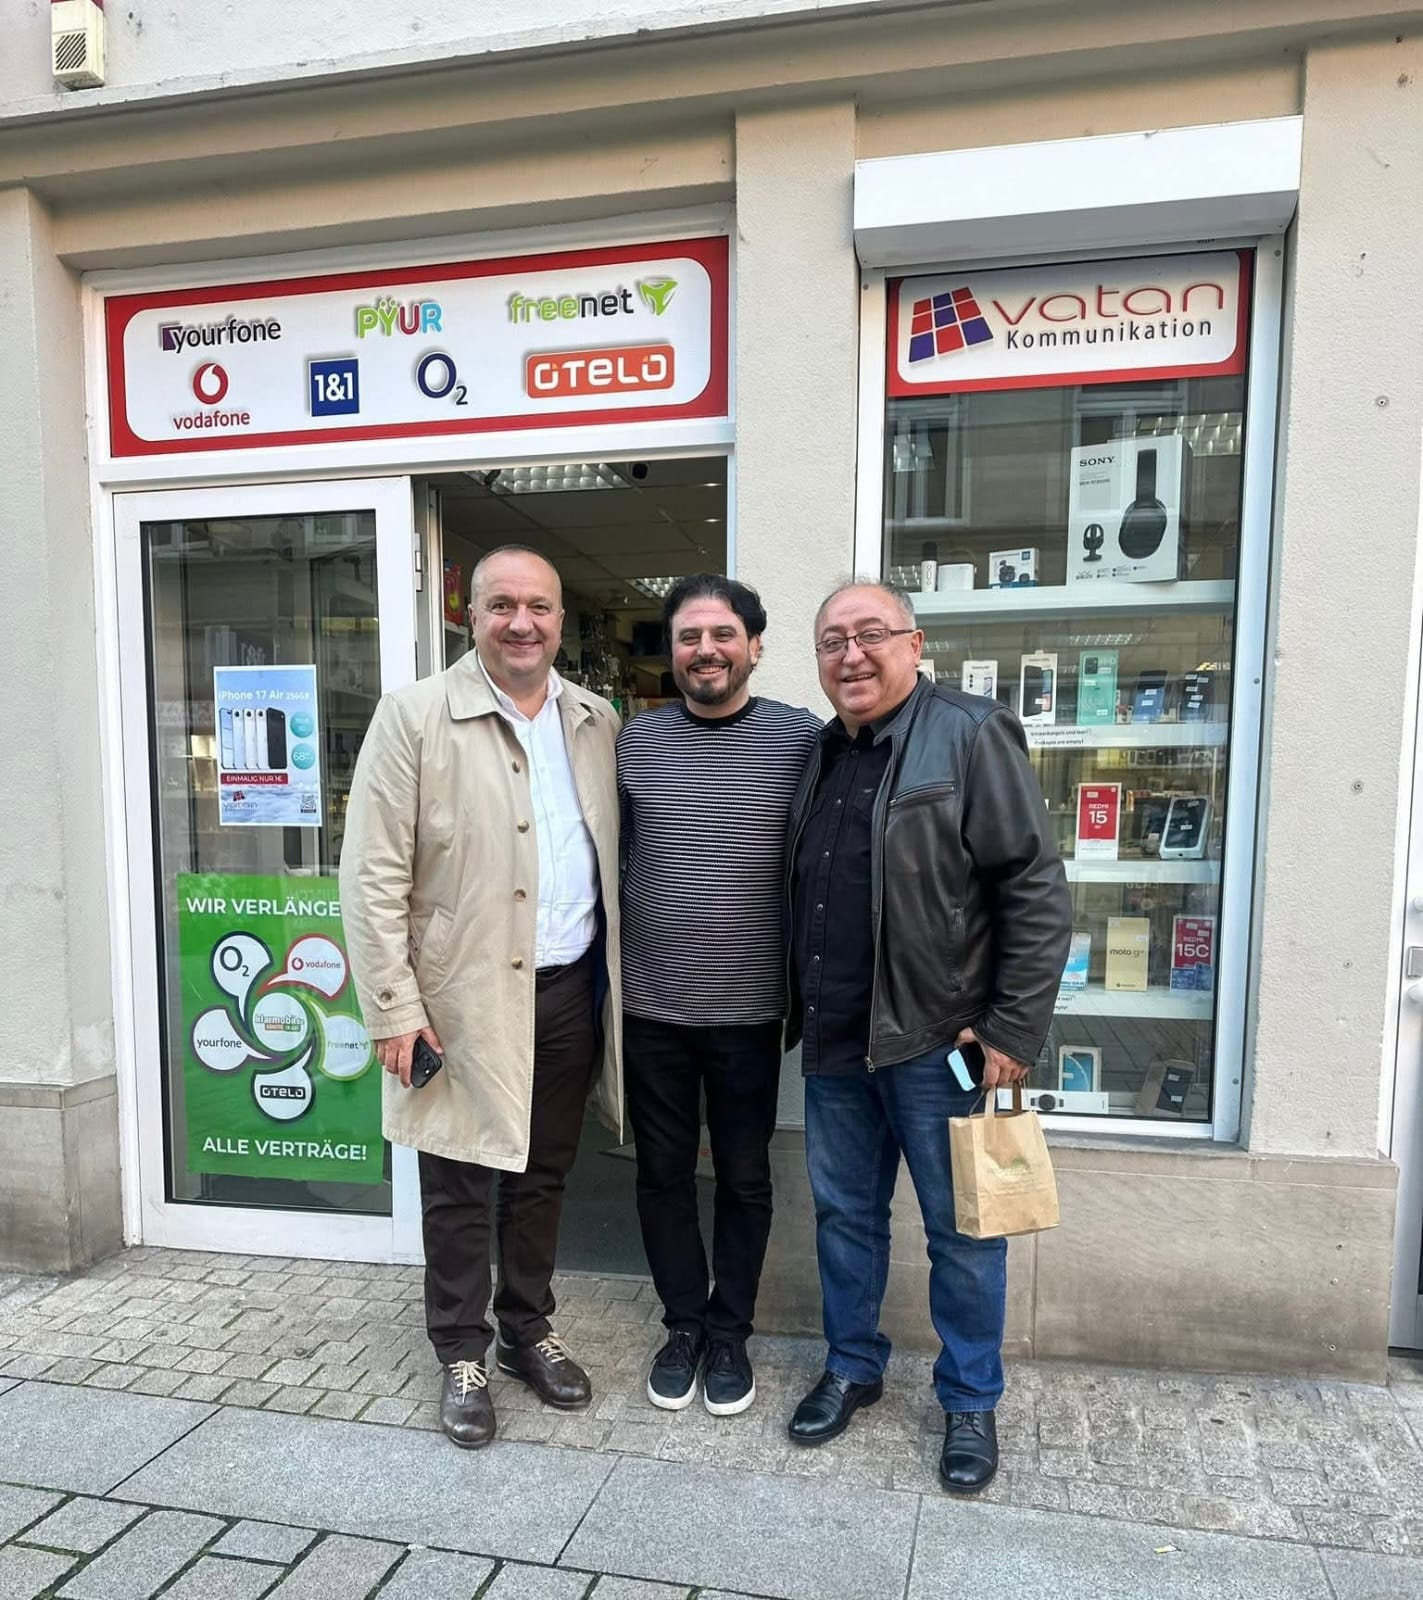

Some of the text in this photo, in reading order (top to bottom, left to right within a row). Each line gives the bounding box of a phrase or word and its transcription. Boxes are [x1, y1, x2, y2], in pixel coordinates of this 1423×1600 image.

[511, 288, 634, 324] freenet
[992, 282, 1224, 325] vatan
[173, 319, 281, 354] yourfone
[1007, 318, 1212, 350] Kommunikation
[314, 371, 355, 403] 1&1
[173, 409, 250, 430] vodafone
[1079, 456, 1115, 467] SONY
[218, 690, 252, 701] iPhone
[255, 690, 267, 700] 17
[269, 690, 284, 700] Air
[1088, 811, 1108, 824] 15
[187, 896, 341, 917] WIR VERLÄNGE
[1110, 948, 1132, 956] moto
[1176, 944, 1209, 958] 15C
[305, 961, 341, 969] vodafone
[197, 1037, 242, 1050] yourfone
[328, 1041, 358, 1049] freenet
[202, 1137, 367, 1161] ALLE VERTRÄGE!
